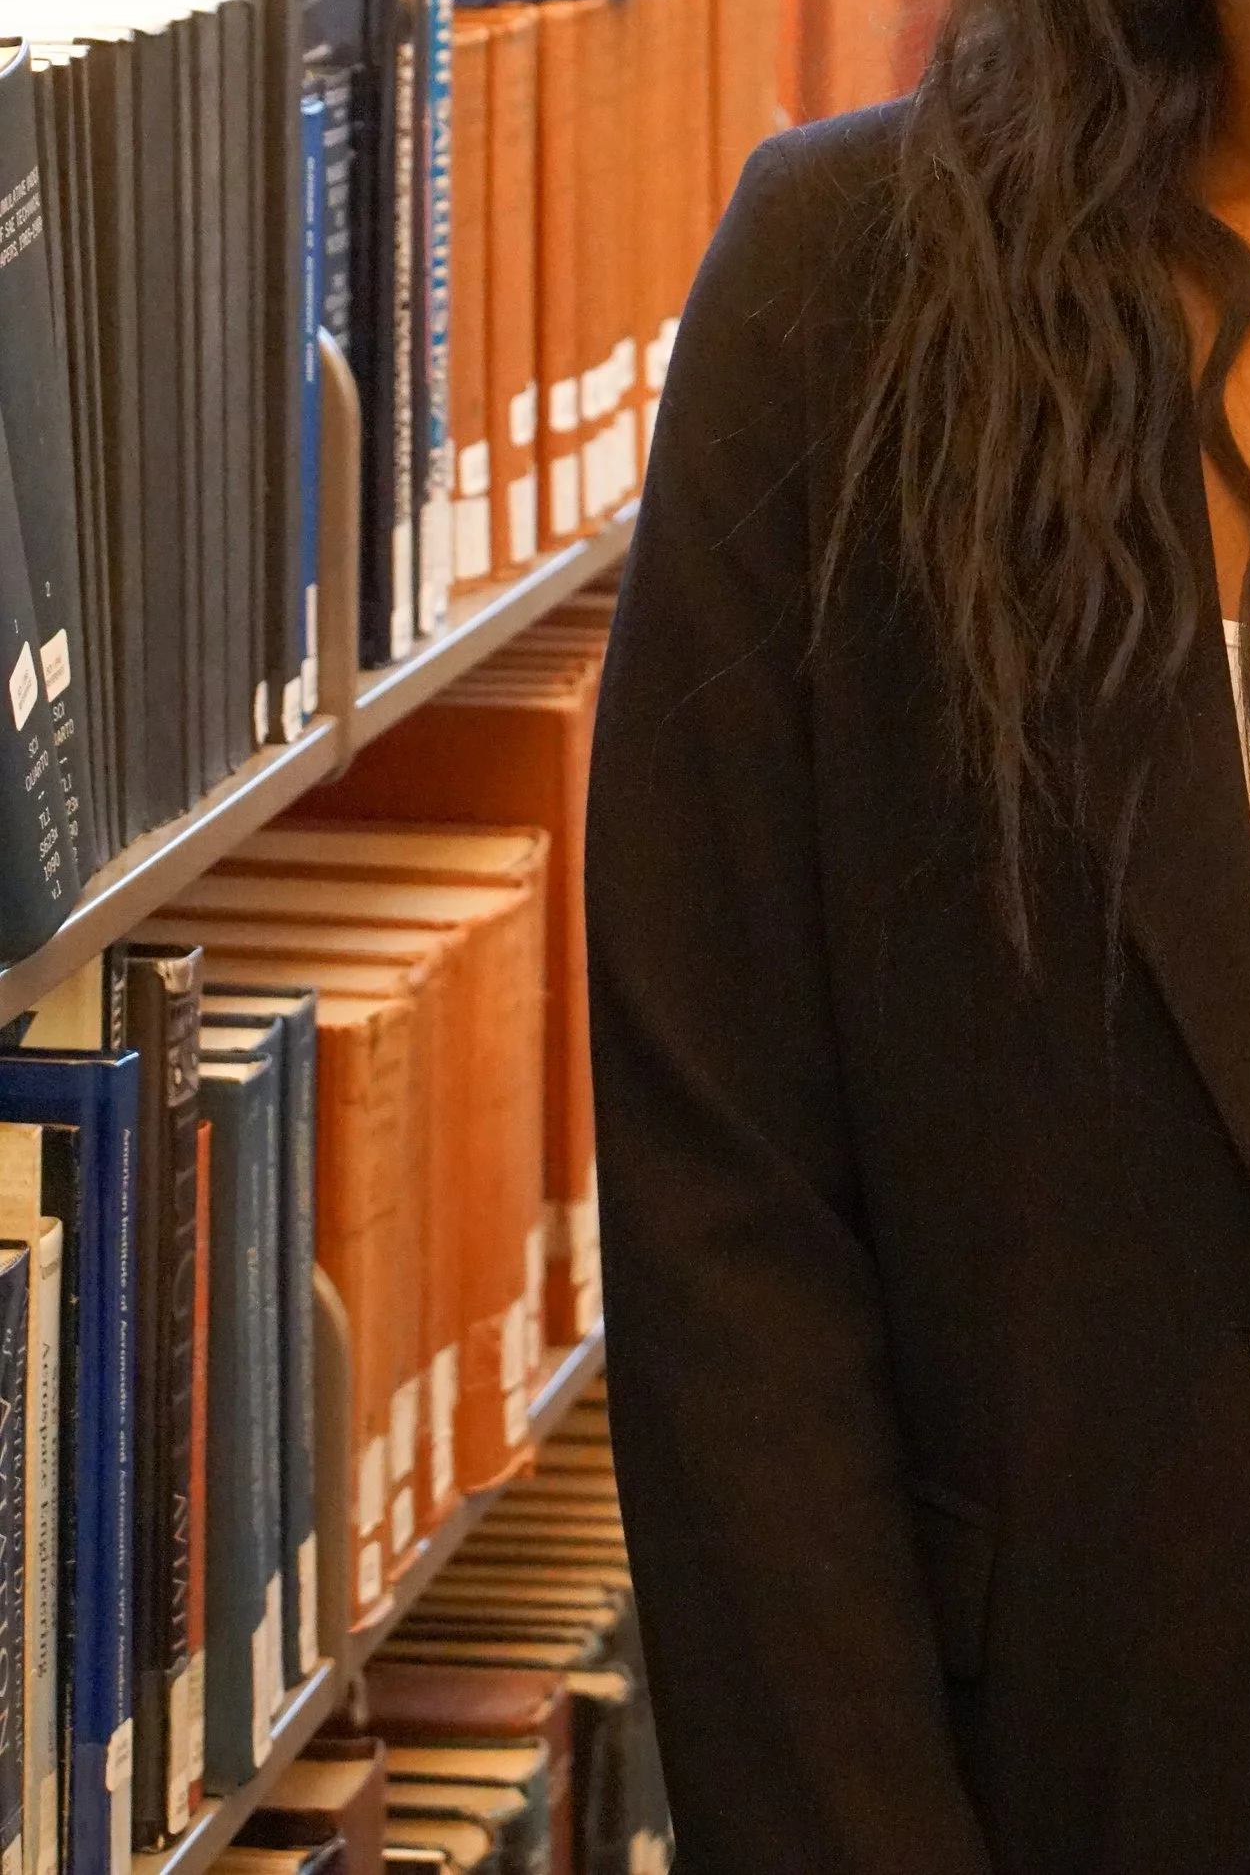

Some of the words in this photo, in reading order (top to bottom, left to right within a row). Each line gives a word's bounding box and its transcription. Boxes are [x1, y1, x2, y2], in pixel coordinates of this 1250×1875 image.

[45, 580, 51, 597] 2
[53, 701, 65, 721] SCI
[28, 735, 39, 758] SCI
[25, 749, 49, 792] QUARTO
[39, 1343, 50, 1486] Aerospace
[37, 1500, 48, 1677] Engineering
